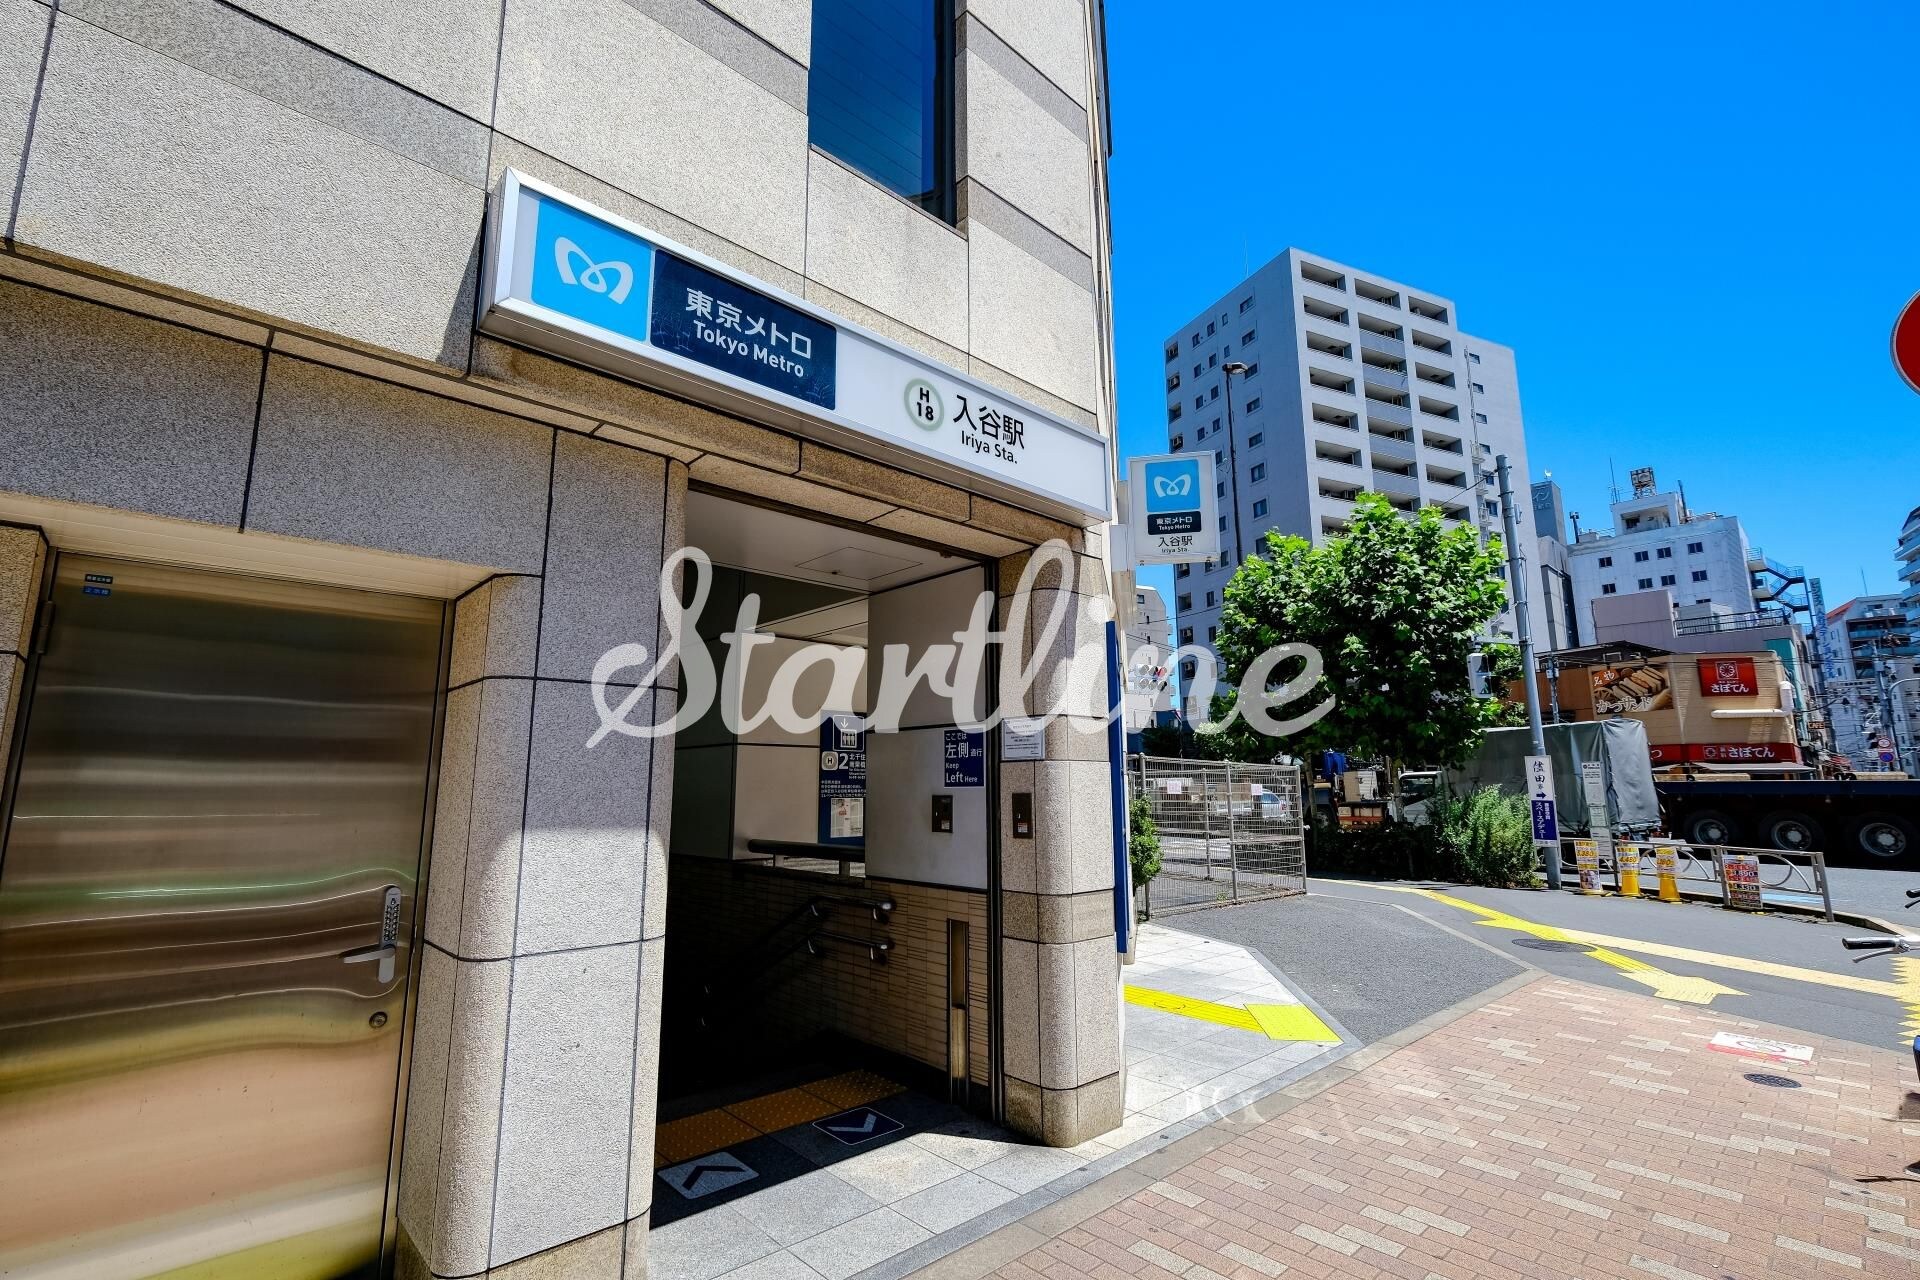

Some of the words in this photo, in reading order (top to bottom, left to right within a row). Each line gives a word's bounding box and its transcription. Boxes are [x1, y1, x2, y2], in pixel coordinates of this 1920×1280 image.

[685, 287, 812, 360] 東京メトロ
[693, 319, 749, 355] Tokyo
[753, 343, 805, 378] Metro
[919, 387, 930, 403] H
[916, 401, 934, 421] 18
[952, 394, 1025, 450] 入谷駅
[961, 430, 990, 453] Iriya
[994, 443, 1018, 464] Sta.
[1156, 516, 1193, 525] 東京メトロ
[1158, 535, 1193, 547] 入谷駅
[945, 732, 968, 741] ここでは
[945, 741, 969, 758] 左側
[839, 752, 849, 770] 2
[945, 762, 960, 770] Keep
[945, 771, 964, 783] Left
[964, 775, 978, 783] Here
